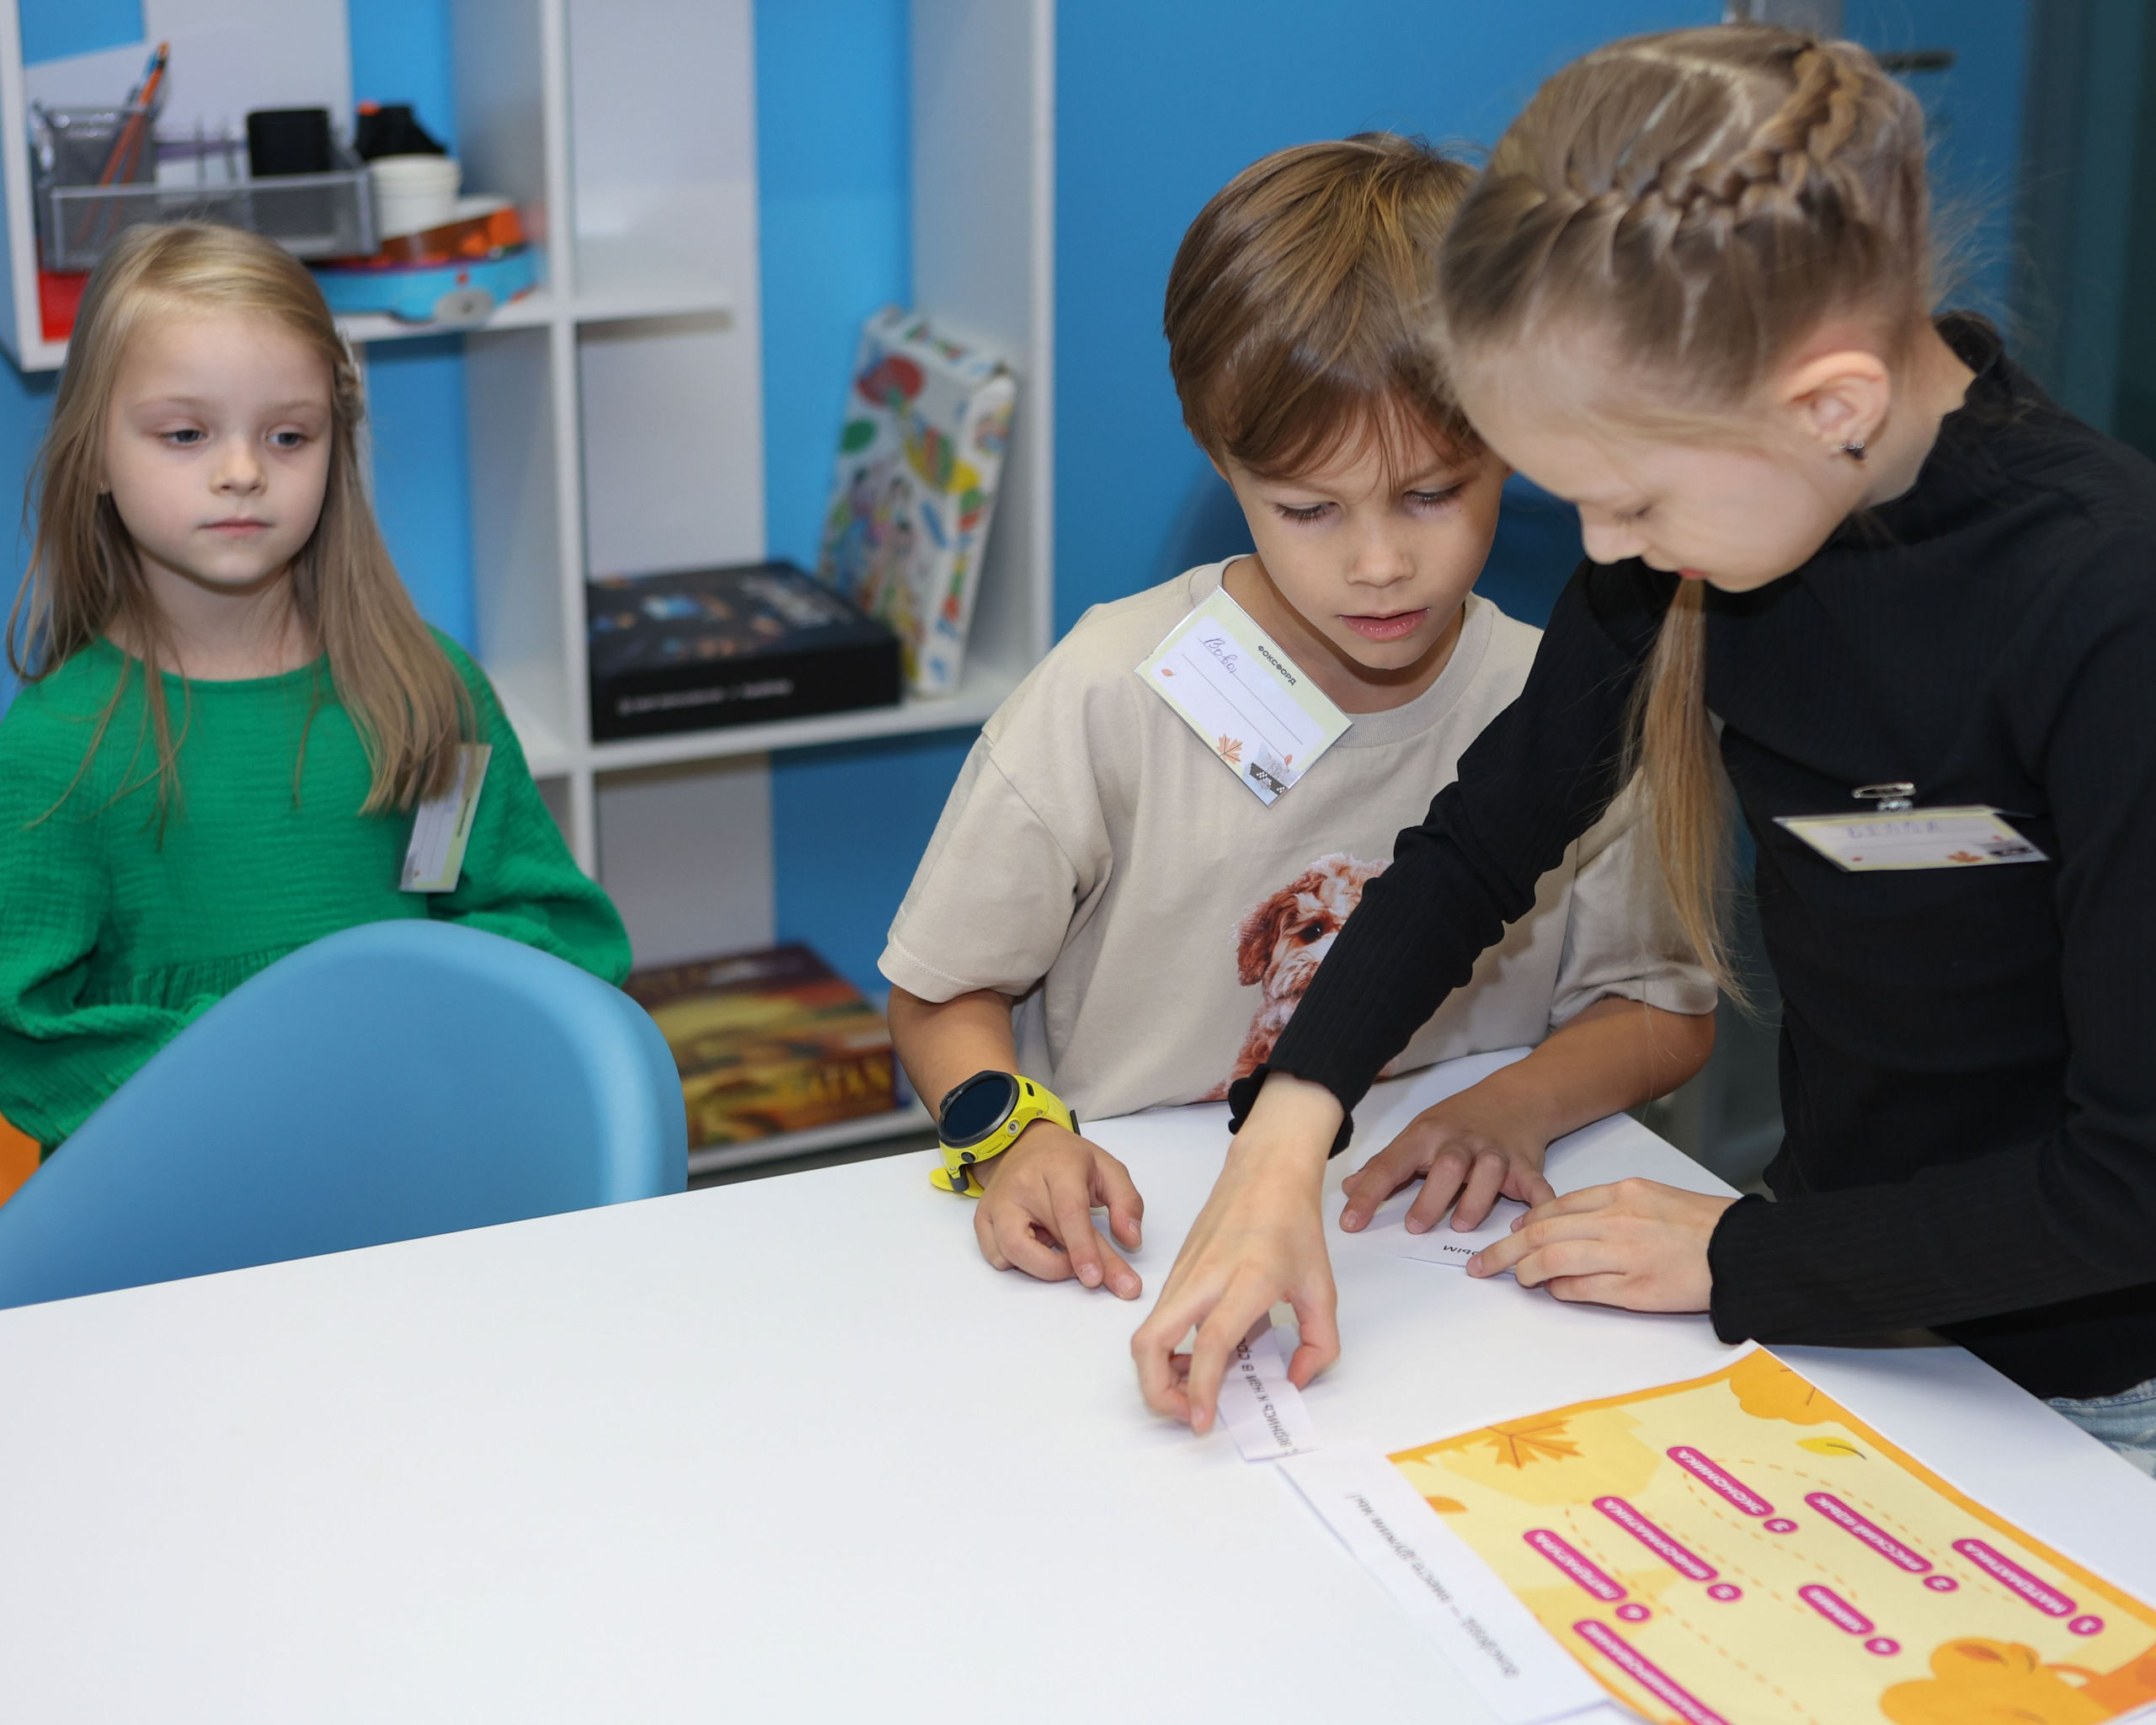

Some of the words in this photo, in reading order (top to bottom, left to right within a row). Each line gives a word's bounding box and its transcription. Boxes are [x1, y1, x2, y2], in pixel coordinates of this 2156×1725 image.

[1203, 638, 1238, 674] Вова
[1257, 645, 1297, 686] ФОКСФОРД
[1677, 1449, 1765, 1515] ЭКОНОМИКА
[1771, 1520, 1790, 1531] 3
[1813, 1496, 1857, 1526] ЯЗЫК
[1370, 1517, 1417, 1562] дружим
[1603, 1498, 1710, 1580] ИНФОРМАТИКА
[1853, 1525, 1924, 1570] РУССКИЙ
[1533, 1530, 1619, 1599] ЛИТЕРАТУРА
[1935, 1578, 1950, 1589] 2
[1963, 1541, 2068, 1614] МАТЕМАТИКА
